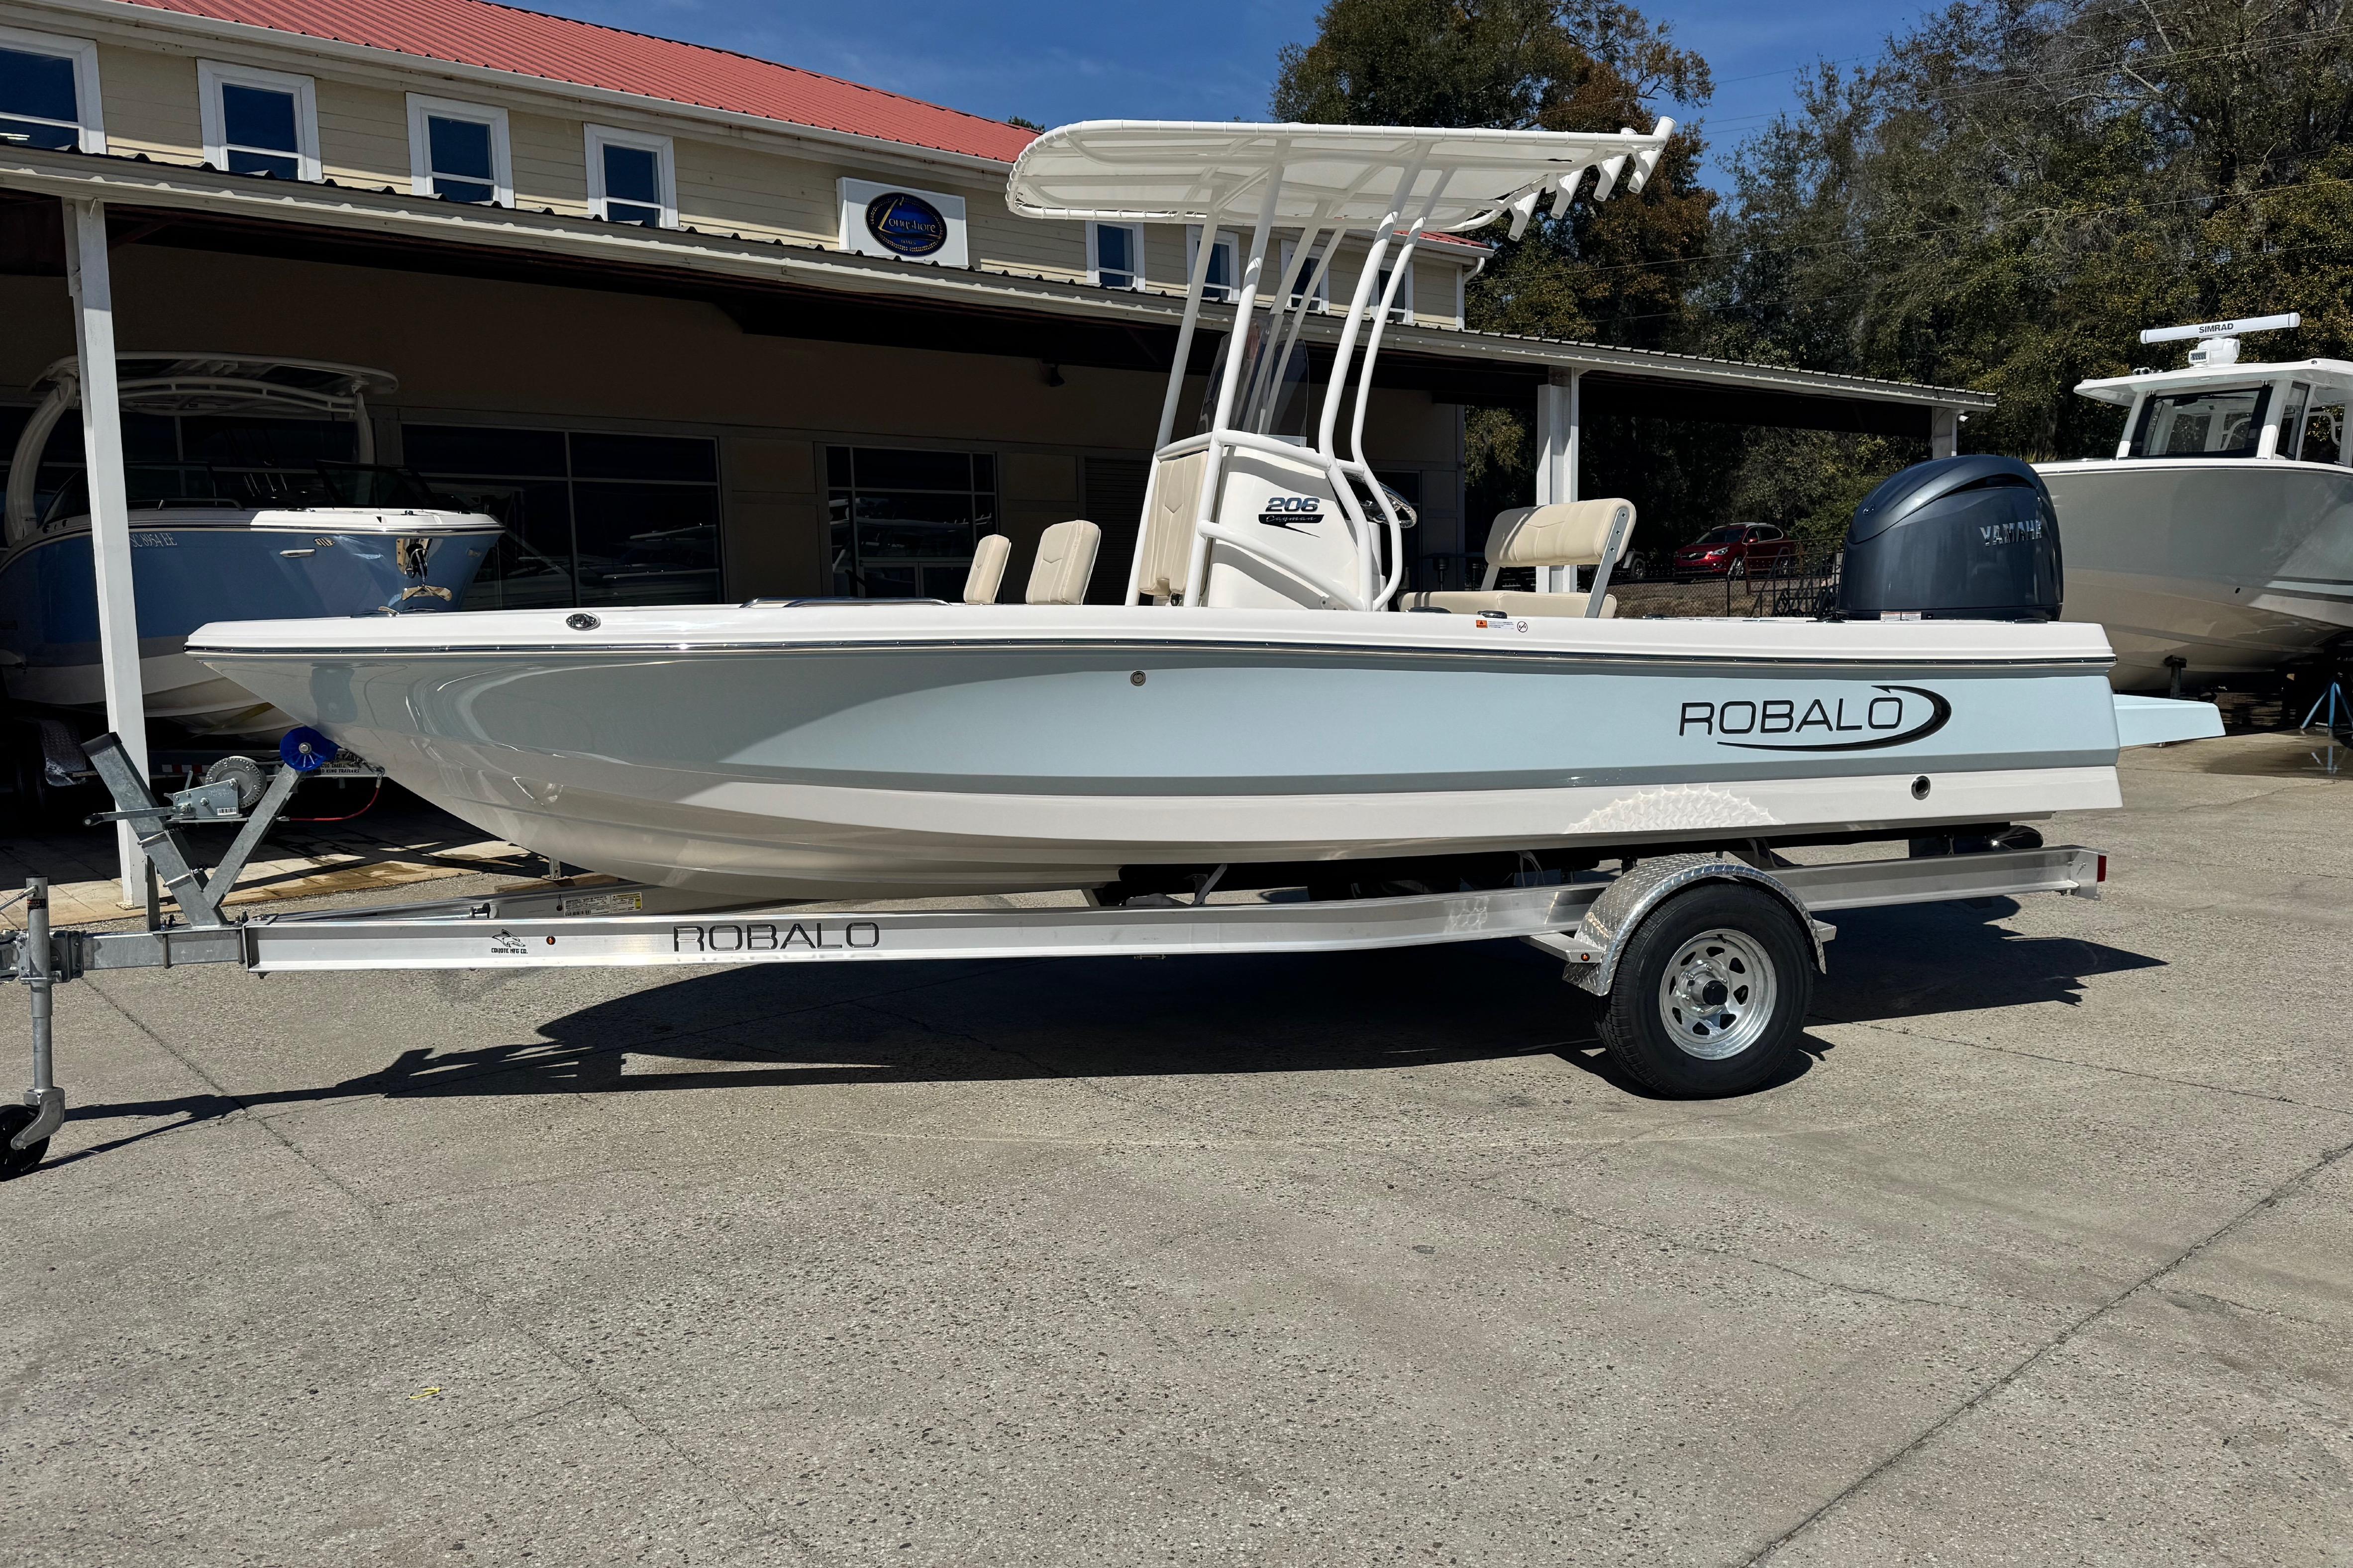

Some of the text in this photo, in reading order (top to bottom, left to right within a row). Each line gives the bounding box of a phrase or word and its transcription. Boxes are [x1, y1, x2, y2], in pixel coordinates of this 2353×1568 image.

[2199, 323, 2234, 333] SIMRAD
[1265, 497, 1320, 512] 206
[1979, 519, 2042, 547] YAMAHA
[1679, 697, 1903, 736] ROBALO
[674, 922, 879, 952] ROBALO
